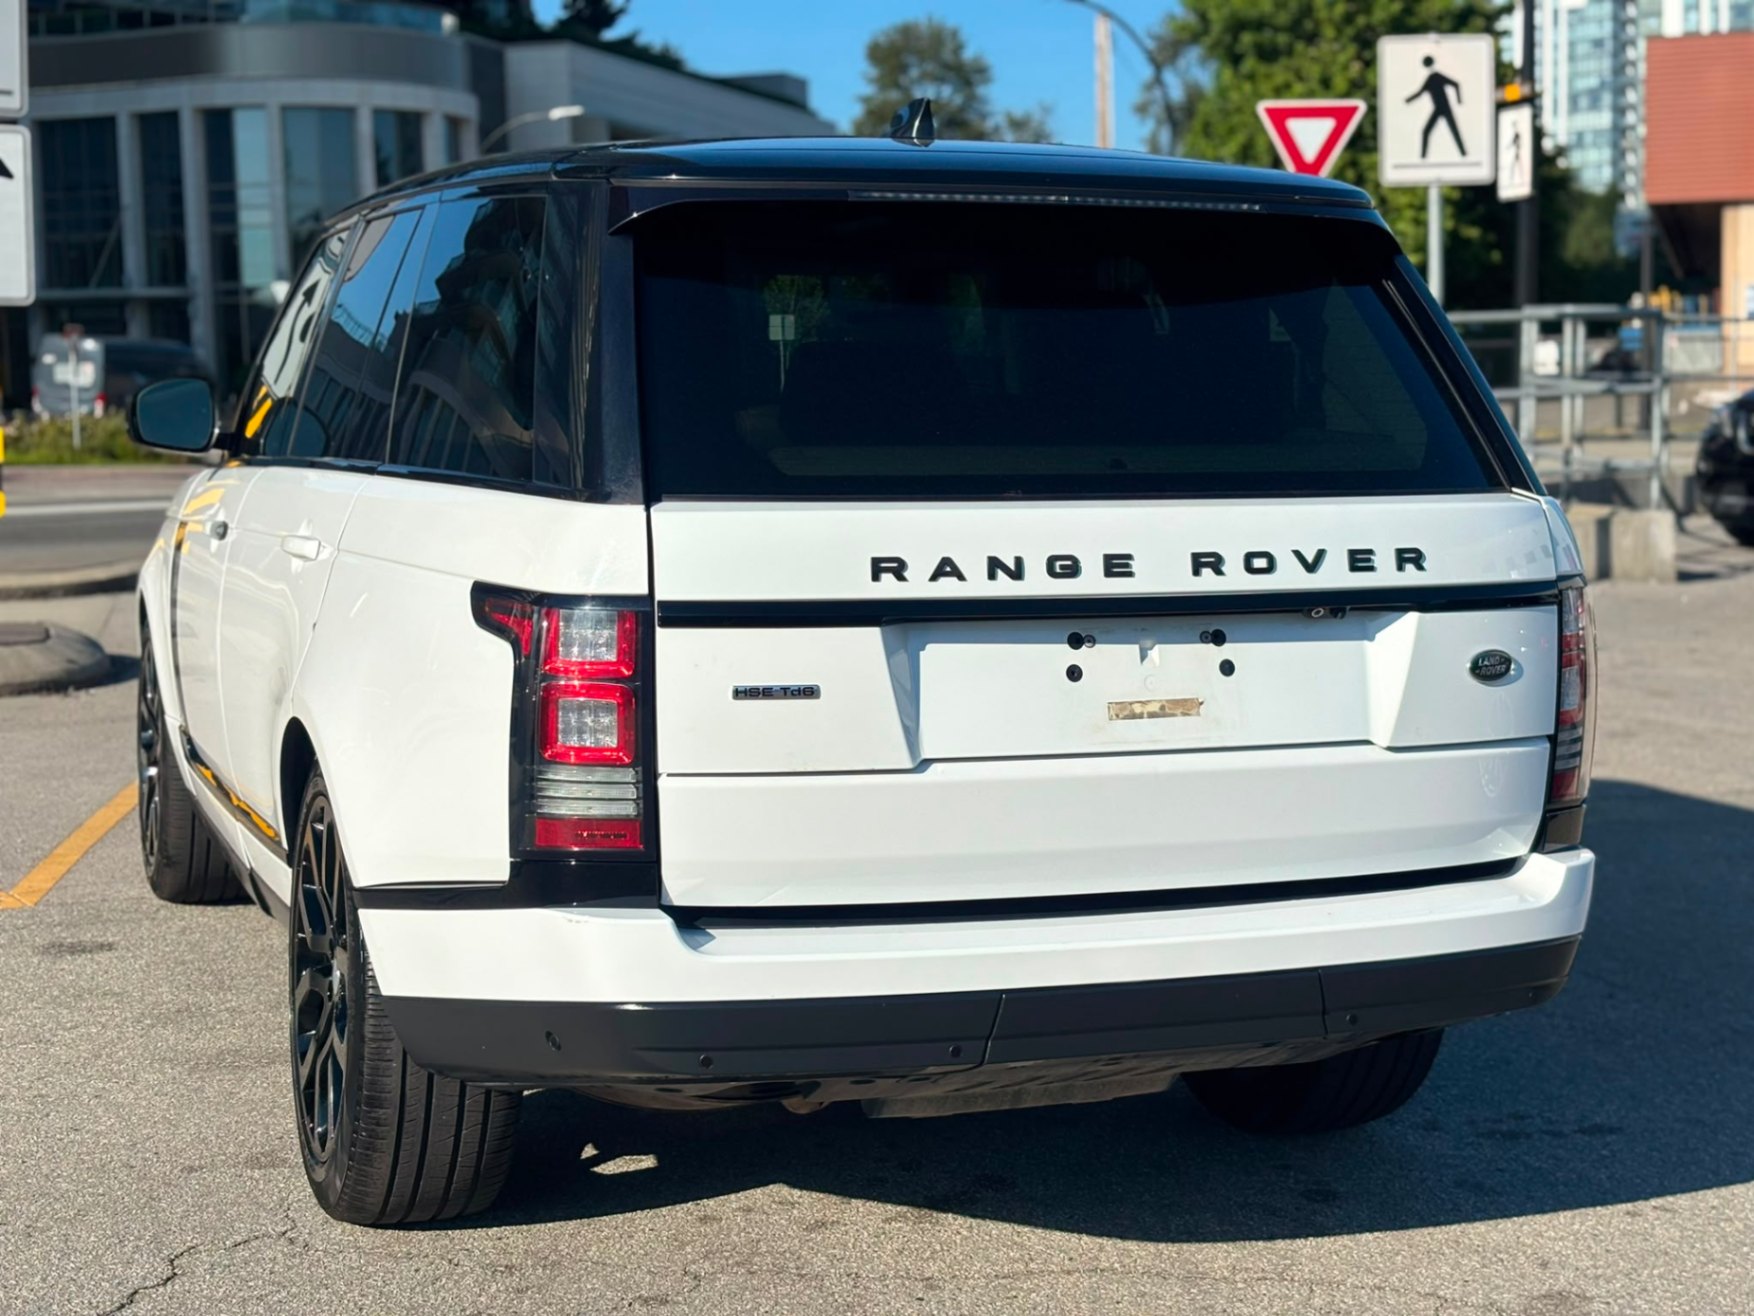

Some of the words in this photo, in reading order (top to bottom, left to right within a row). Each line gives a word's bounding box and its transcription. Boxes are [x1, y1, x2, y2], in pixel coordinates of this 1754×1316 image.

[870, 553, 1136, 582] RANGE
[1190, 547, 1427, 577] ROVER
[1478, 655, 1501, 667] LAND
[735, 687, 774, 697] HSE
[780, 686, 815, 697] Td6
